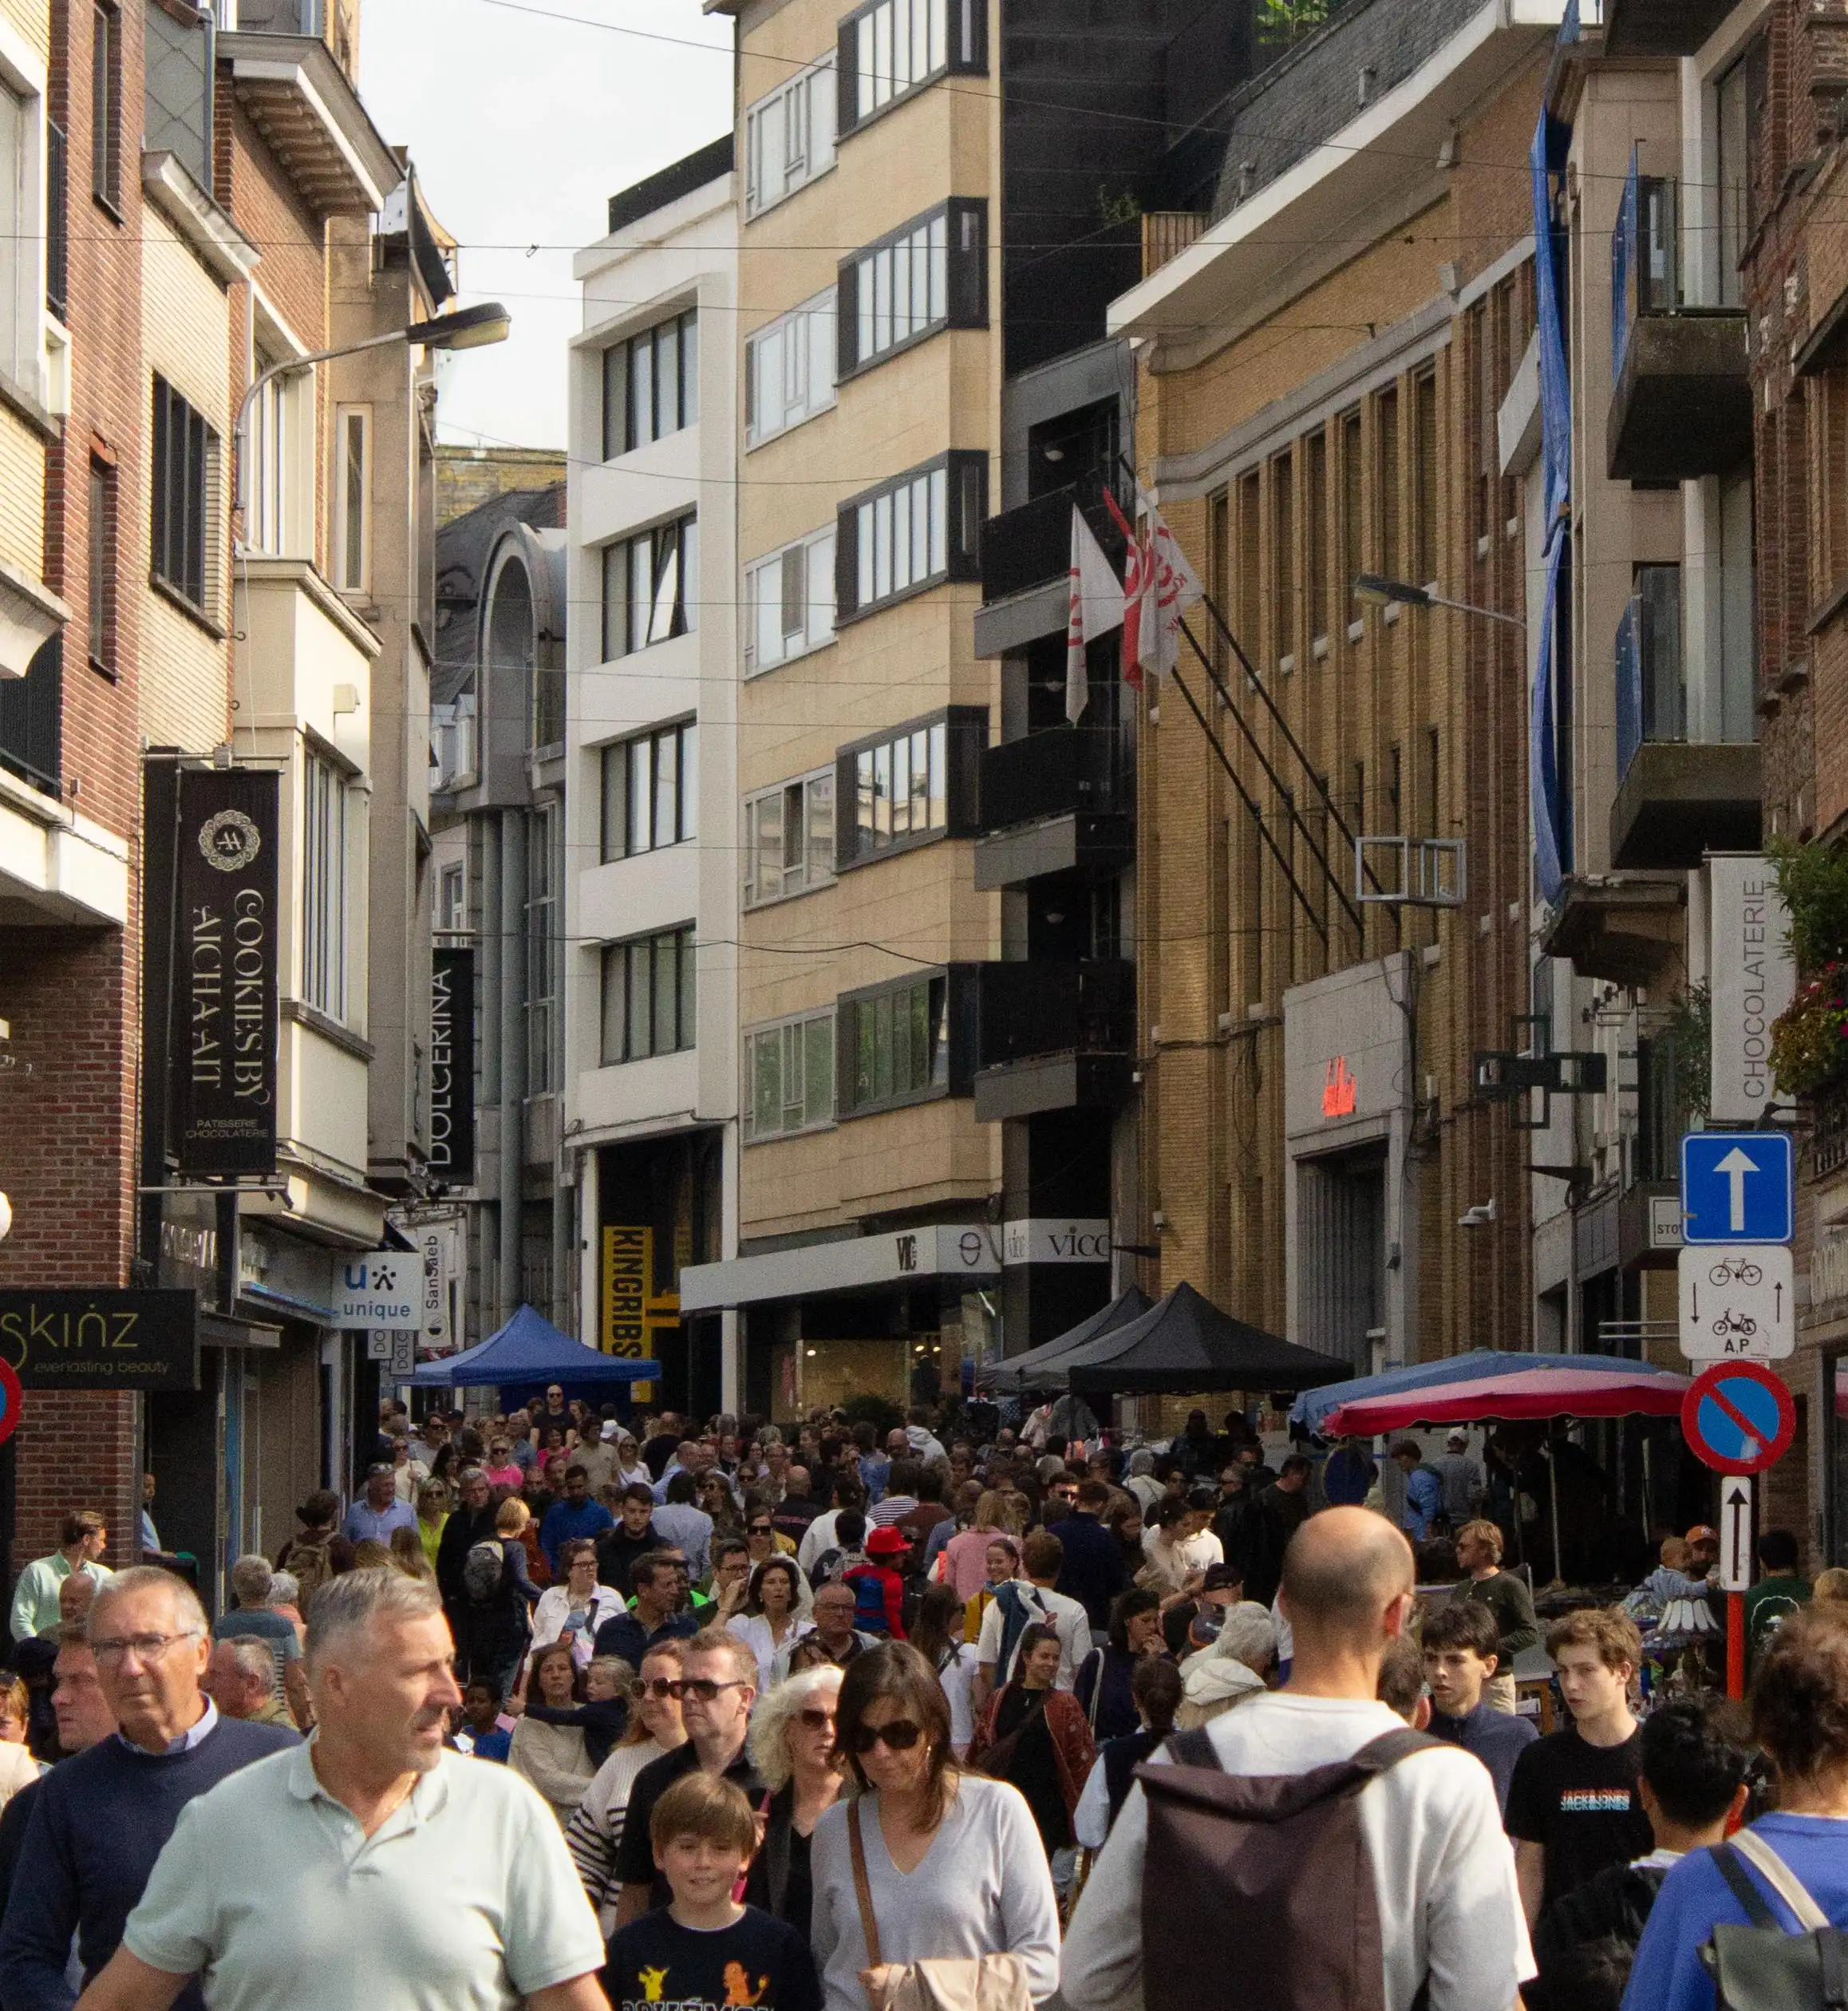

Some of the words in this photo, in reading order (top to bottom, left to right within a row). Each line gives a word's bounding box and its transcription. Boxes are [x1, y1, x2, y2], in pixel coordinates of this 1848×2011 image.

[192, 905, 222, 1022] AICHA
[235, 888, 264, 1053] COOKIES
[1743, 880, 1766, 1099] CHOCOLATERIE
[192, 1029, 222, 1088] AIT
[235, 1059, 271, 1106] BY
[431, 968, 452, 1166] DOLCERINA
[185, 1129, 270, 1139] CHOCOLATERIE
[196, 1119, 259, 1128] PATISSERIE
[343, 1301, 411, 1321] unique
[612, 1229, 645, 1357] KINGRIBS
[34, 1360, 113, 1376] everlasting
[117, 1360, 169, 1376] beauty
